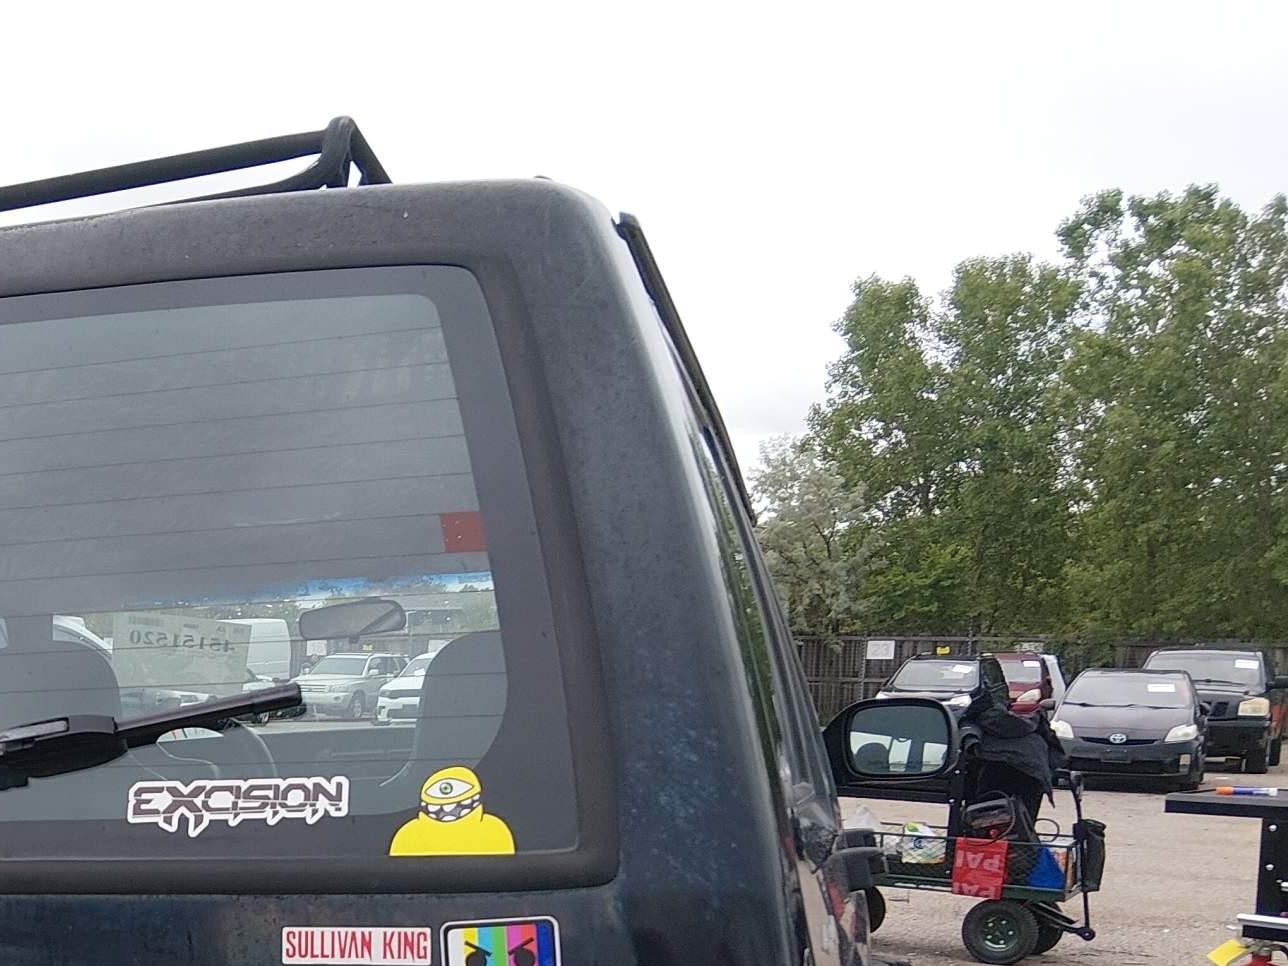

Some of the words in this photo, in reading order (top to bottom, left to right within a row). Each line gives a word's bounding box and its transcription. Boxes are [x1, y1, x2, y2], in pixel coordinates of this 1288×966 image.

[130, 778, 346, 835] EXCISION
[285, 930, 372, 960] SULLIVAN
[382, 931, 428, 960] KING
